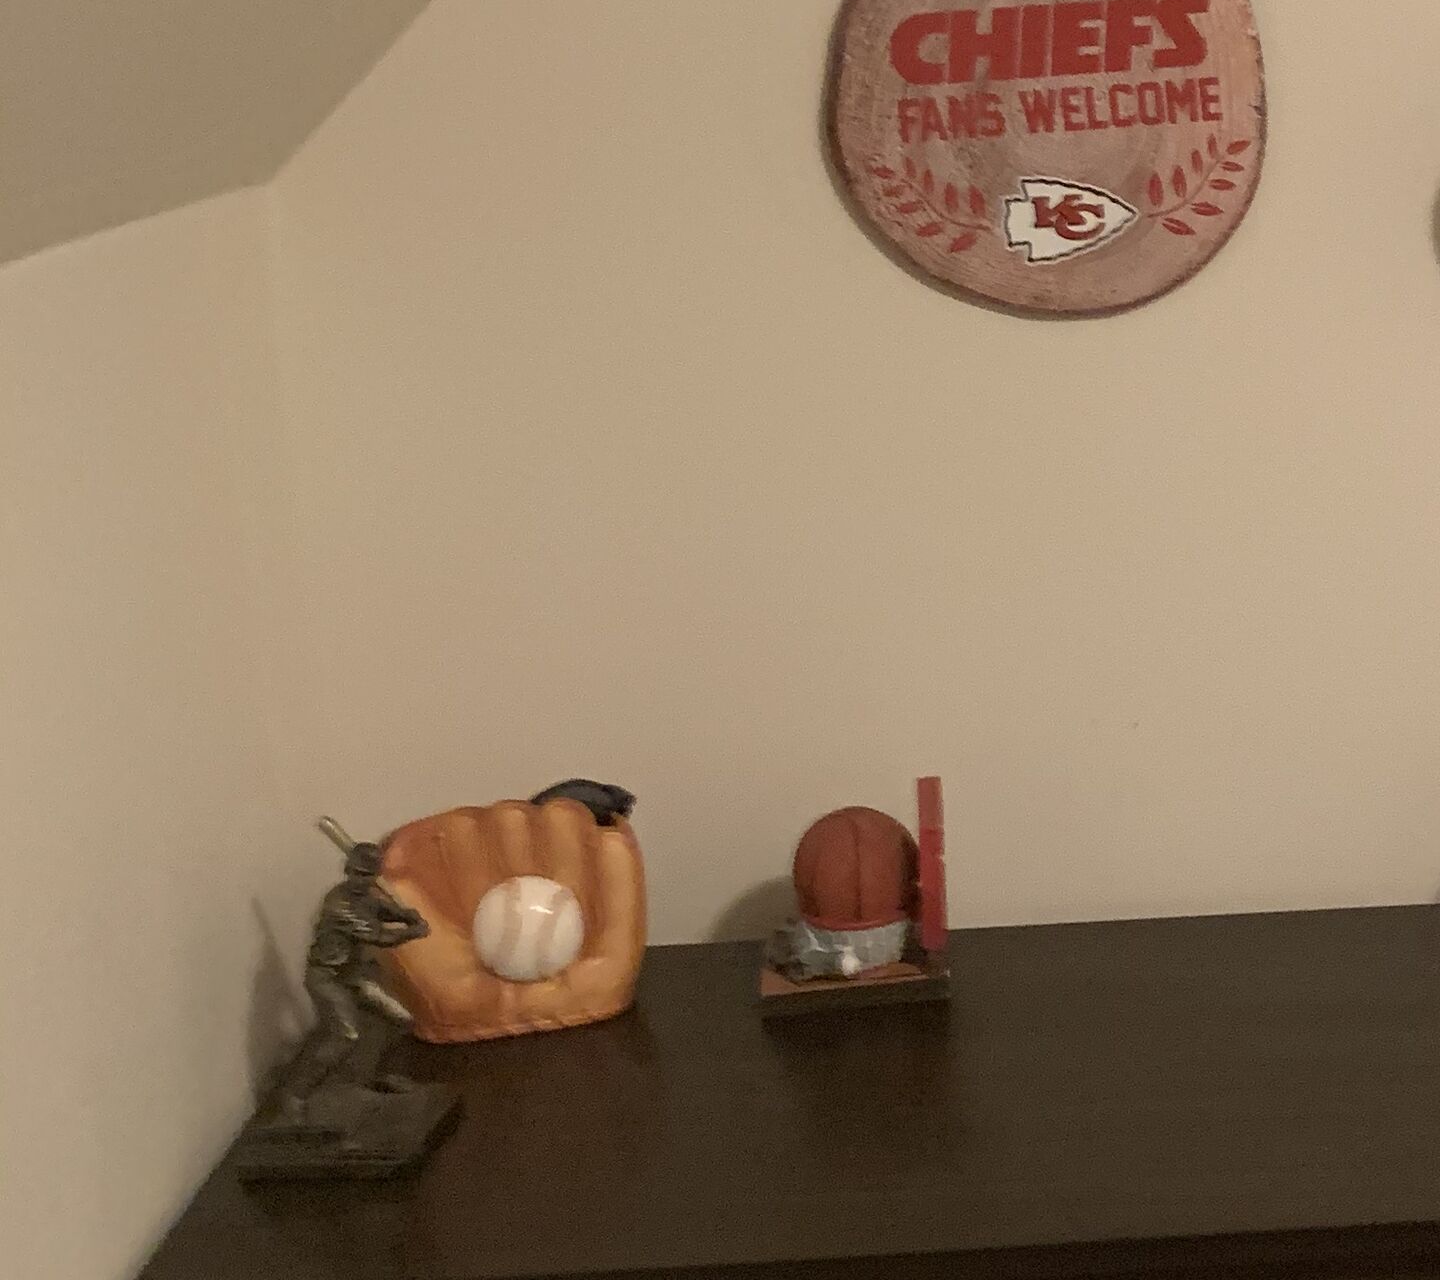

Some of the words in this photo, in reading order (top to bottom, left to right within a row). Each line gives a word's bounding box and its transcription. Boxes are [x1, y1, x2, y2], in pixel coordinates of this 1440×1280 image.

[896, 90, 1007, 144] FANS
[1018, 77, 1224, 135] WELCOME
[1031, 193, 1106, 241] KC
